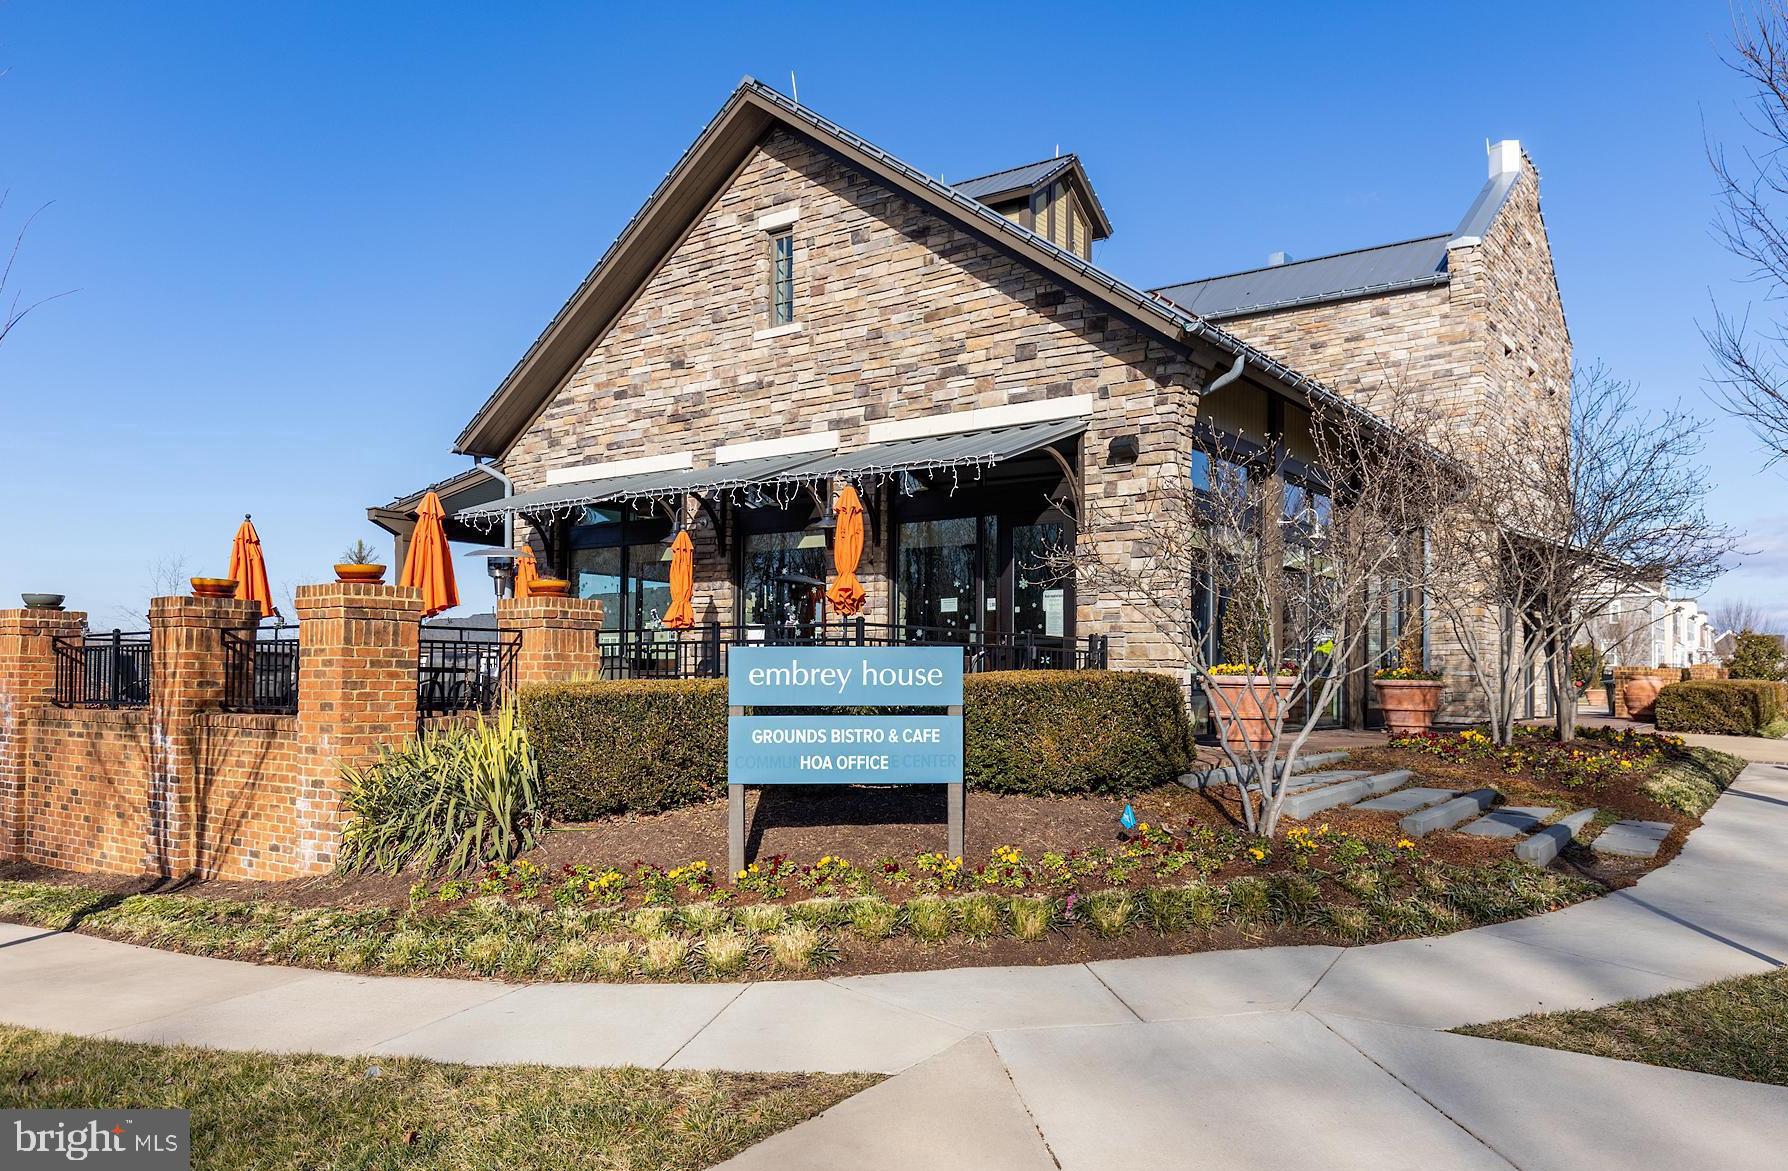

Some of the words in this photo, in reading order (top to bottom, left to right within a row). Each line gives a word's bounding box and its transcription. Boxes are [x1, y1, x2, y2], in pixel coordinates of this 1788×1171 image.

[749, 659, 852, 694] embrey
[862, 659, 943, 686] house
[752, 728, 827, 744] GROUNDS
[831, 728, 885, 743] BISTRO
[888, 728, 899, 743] &
[903, 728, 940, 743] CAFE
[800, 755, 833, 770] HOA
[836, 755, 889, 770] OFFICE
[903, 754, 957, 769] CENTER
